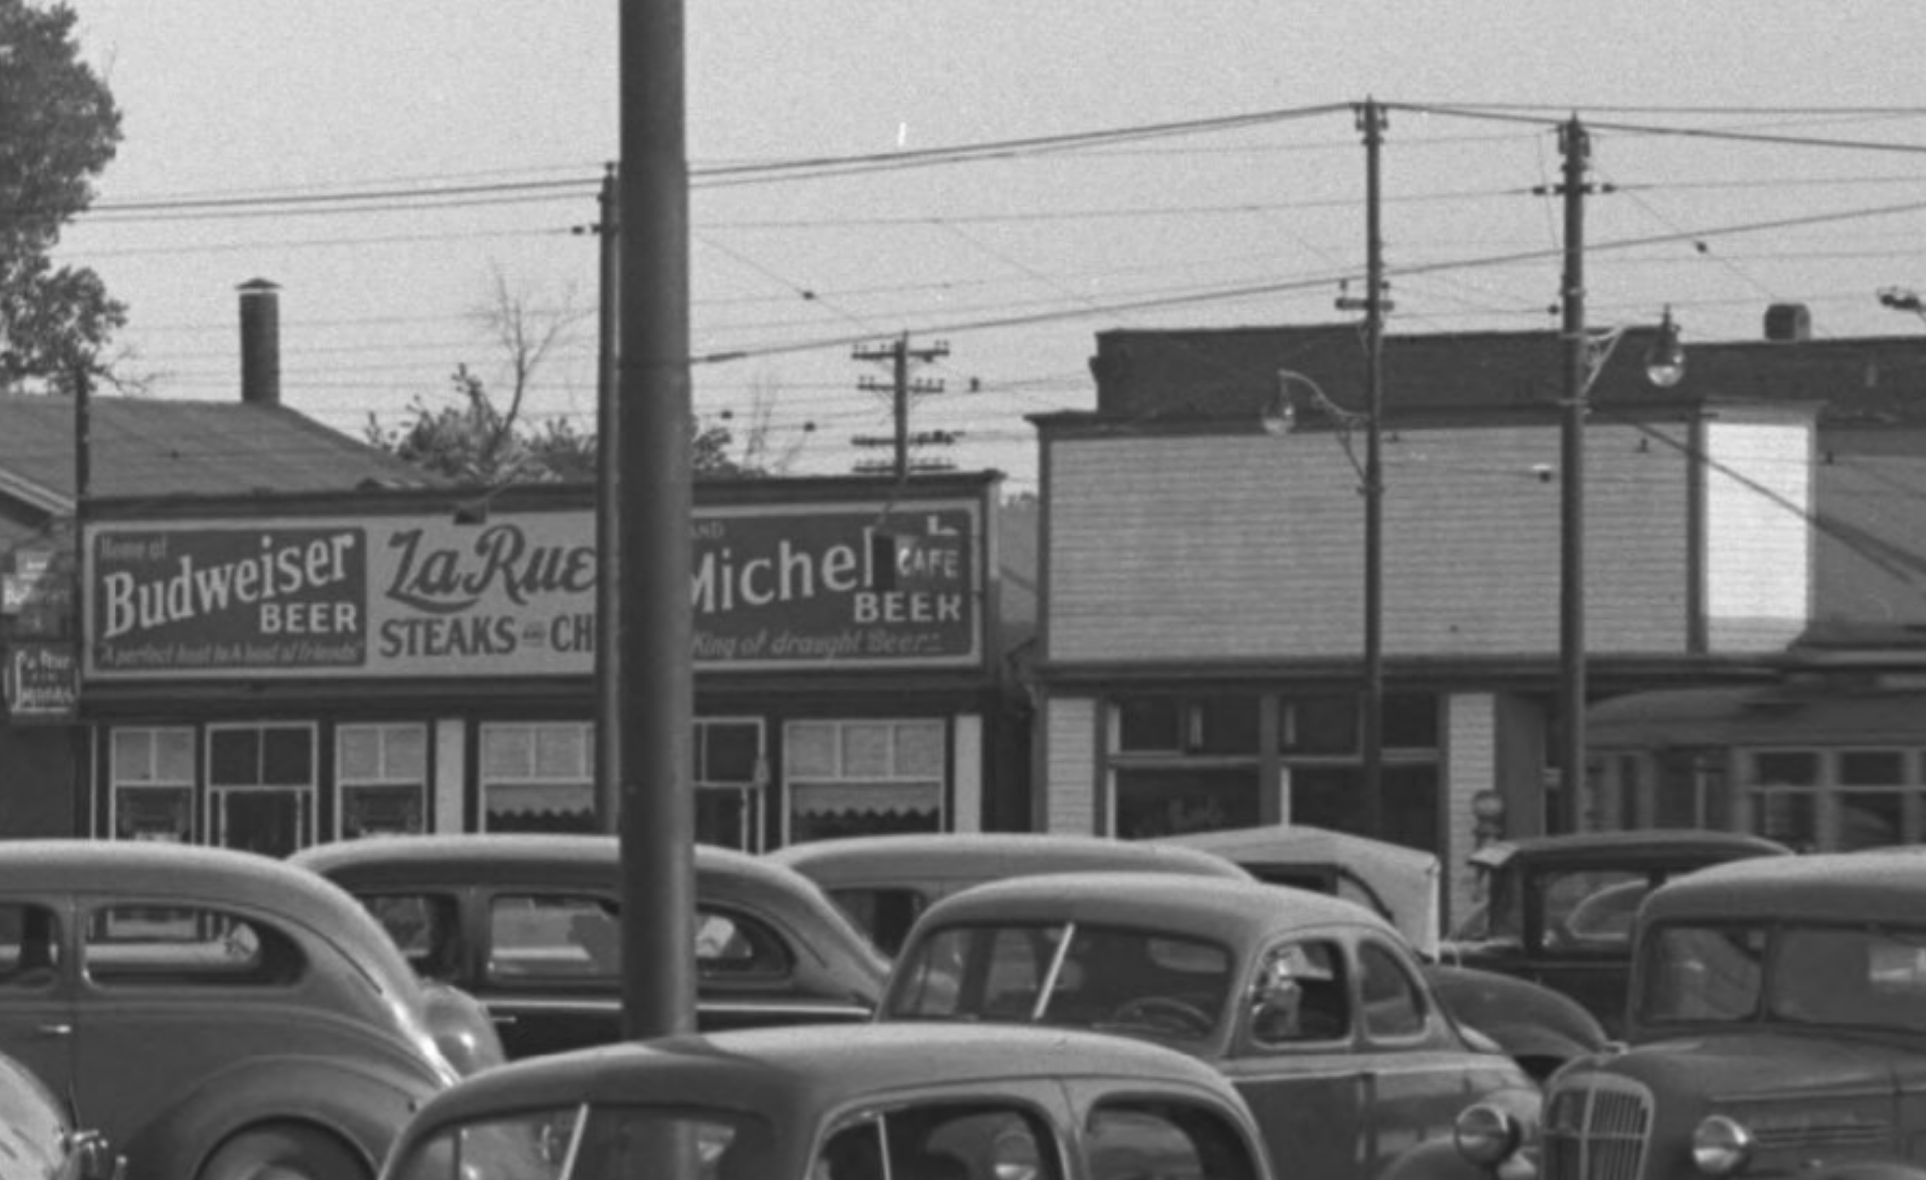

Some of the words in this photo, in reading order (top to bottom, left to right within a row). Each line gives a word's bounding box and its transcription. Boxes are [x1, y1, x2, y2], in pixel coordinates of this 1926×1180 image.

[103, 534, 354, 638] Budweiser
[261, 603, 357, 632] BEER
[854, 592, 961, 622] BEER
[380, 615, 517, 657] STEAKS
